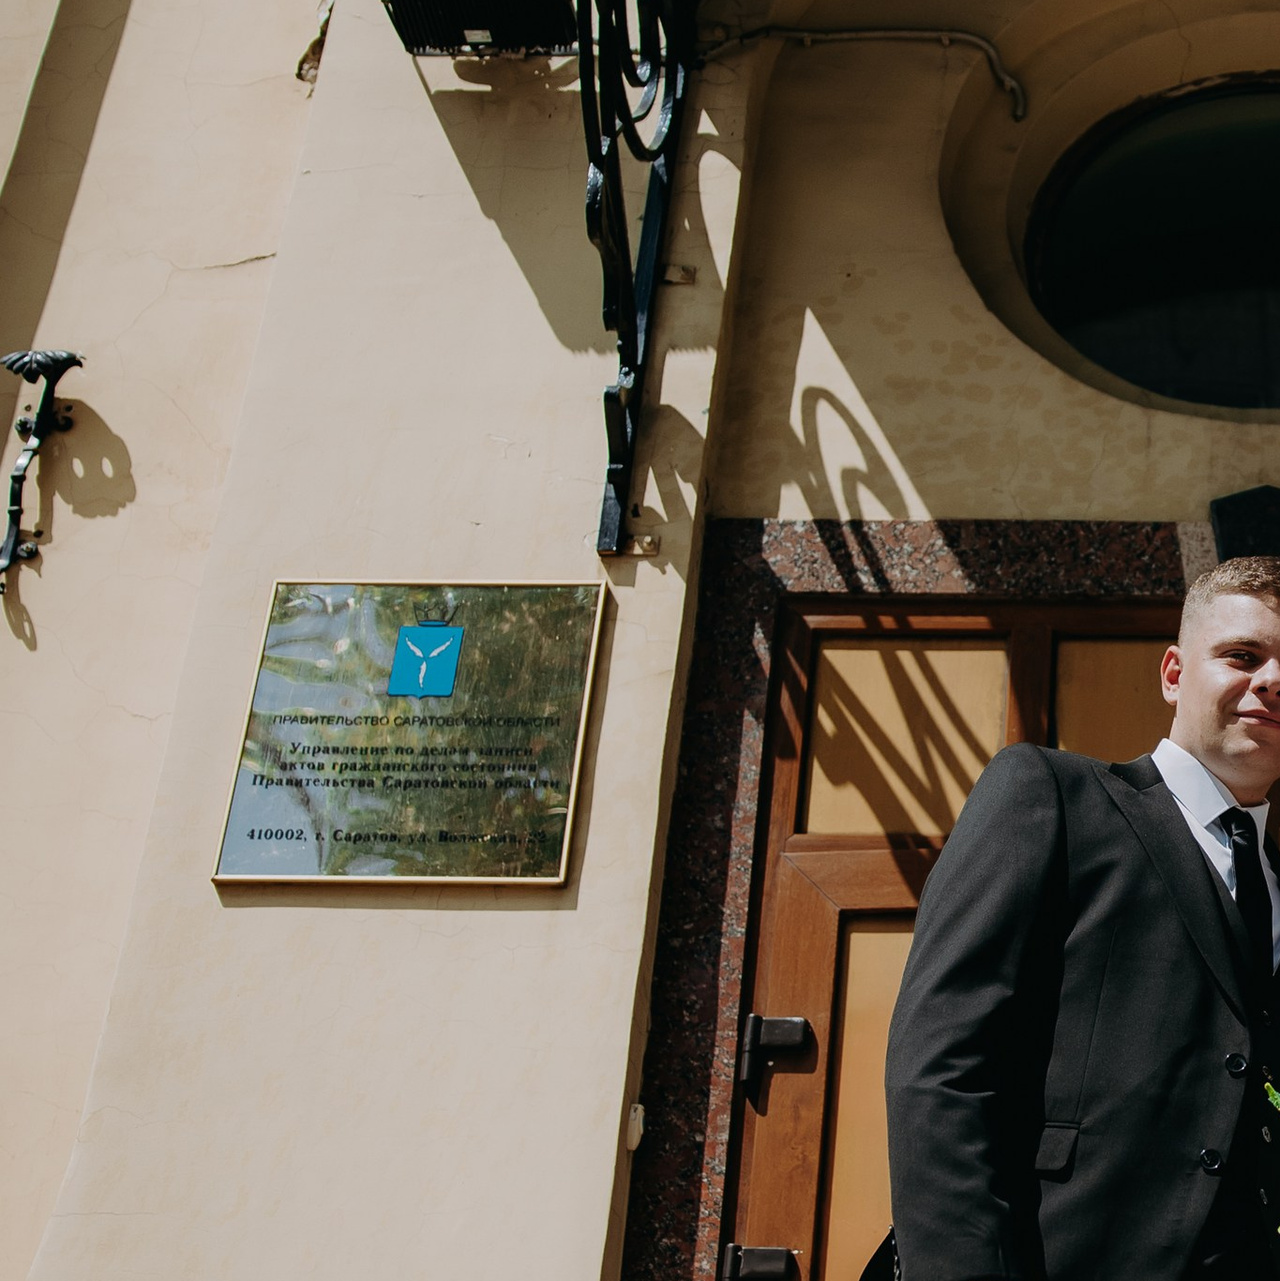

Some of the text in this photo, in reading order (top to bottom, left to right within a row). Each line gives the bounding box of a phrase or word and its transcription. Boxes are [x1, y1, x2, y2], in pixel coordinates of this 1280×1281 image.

[273, 715, 389, 726] ПРАВИТЕЛЬСТВО
[290, 742, 389, 756] Управление
[394, 747, 414, 755] по
[279, 762, 325, 771] актов
[331, 762, 446, 774] гражданского
[252, 774, 375, 789] Правительства
[247, 828, 307, 842] 410002,
[333, 829, 402, 844] Саратов,
